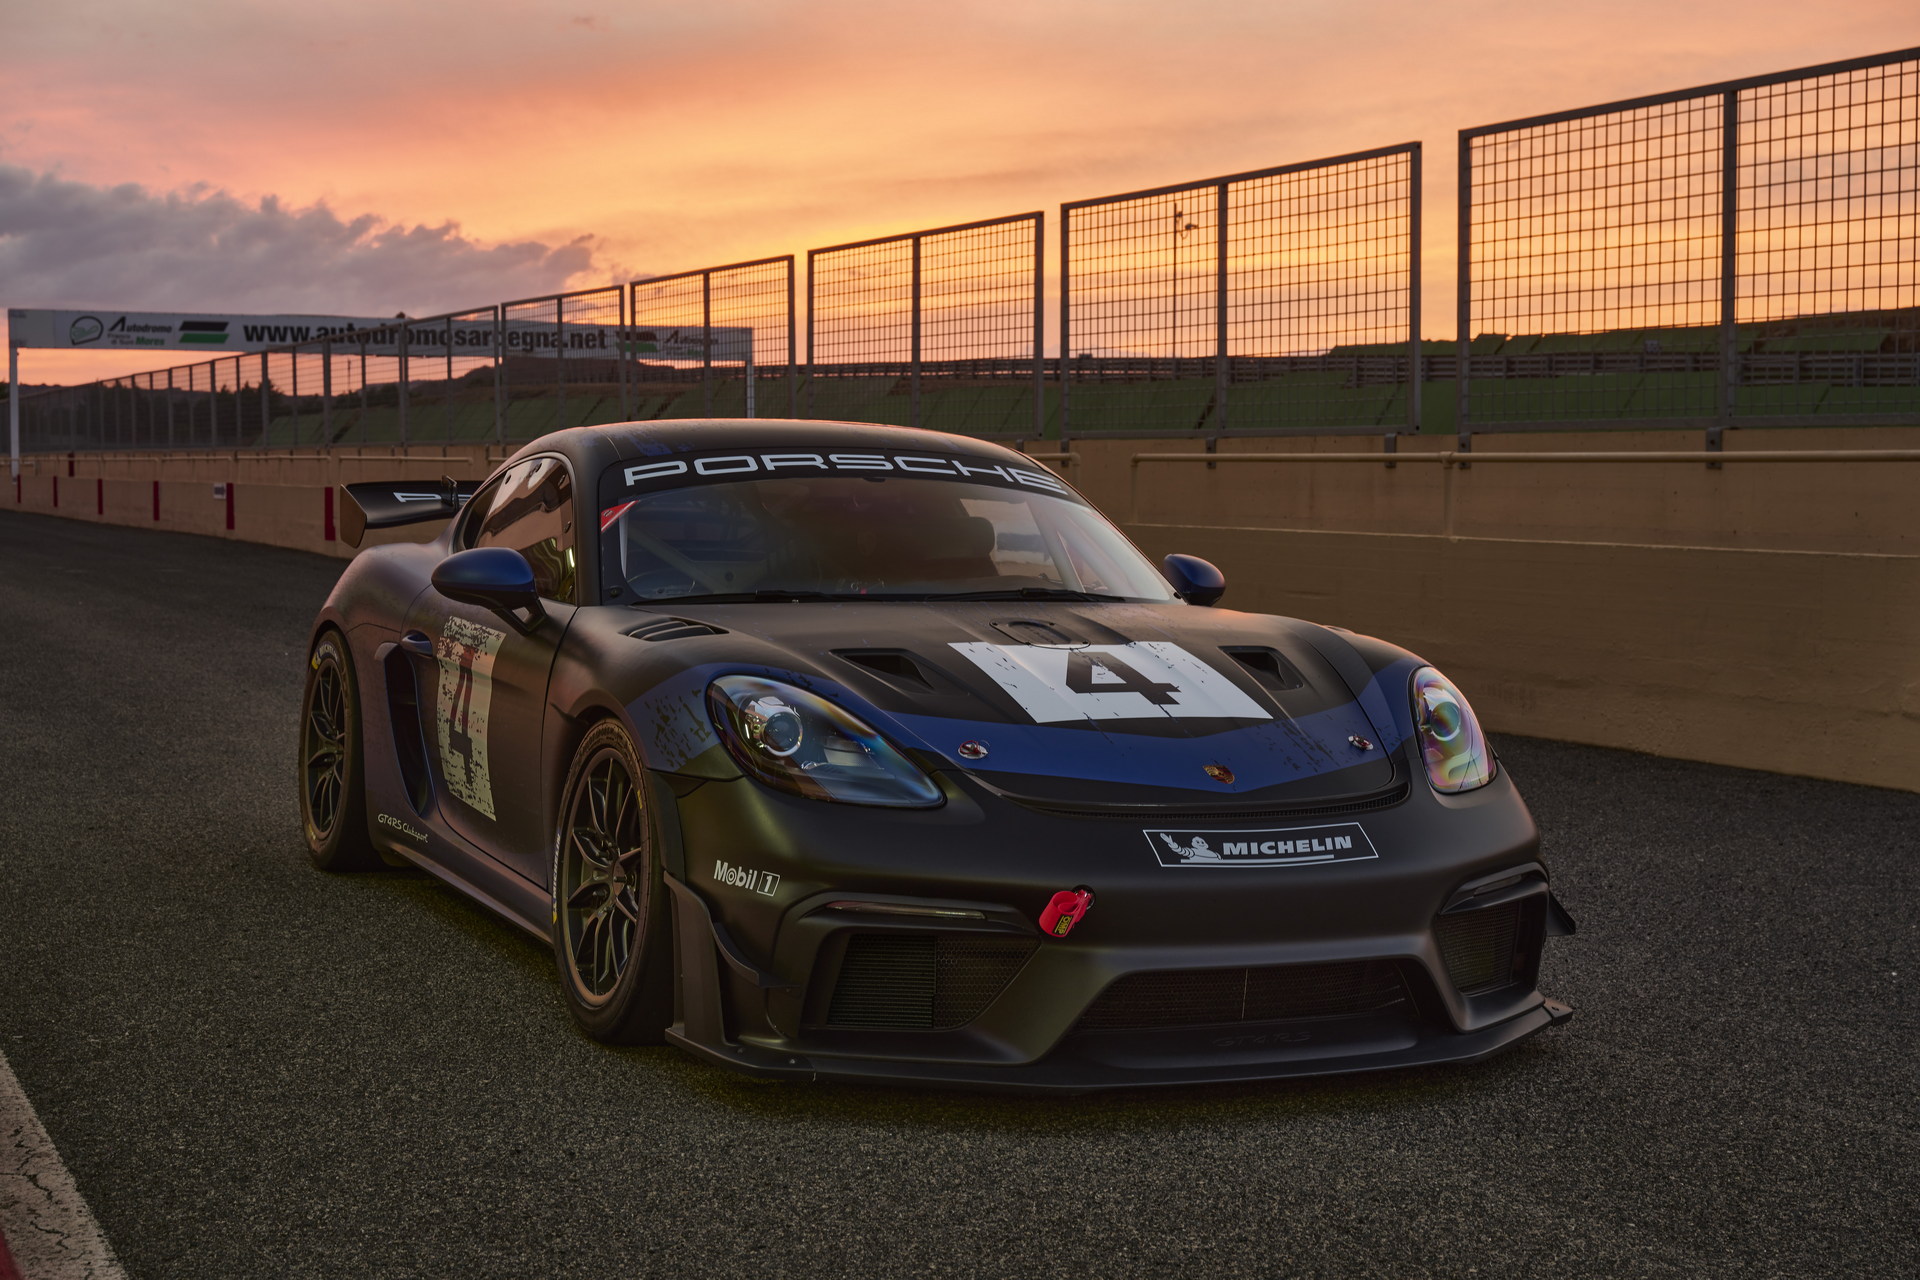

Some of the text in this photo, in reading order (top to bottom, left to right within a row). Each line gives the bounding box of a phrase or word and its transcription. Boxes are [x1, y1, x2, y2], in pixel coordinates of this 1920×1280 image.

[108, 315, 172, 333] Autodromo
[624, 453, 1068, 495] PORSCHE
[1066, 652, 1181, 705] 4
[1222, 836, 1352, 856] MICHELIN
[713, 859, 758, 890] Mobil
